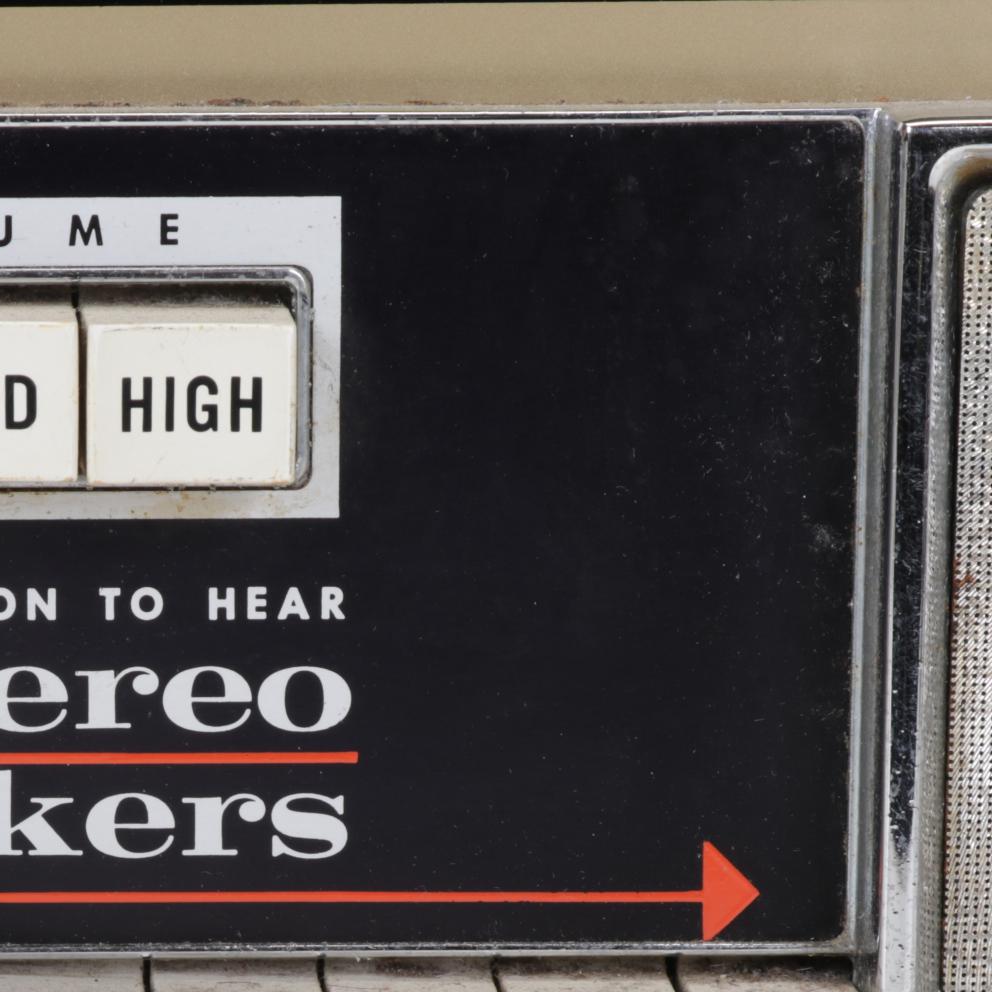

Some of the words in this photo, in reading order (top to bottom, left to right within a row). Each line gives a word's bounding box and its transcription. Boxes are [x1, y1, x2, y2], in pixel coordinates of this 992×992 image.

[121, 375, 263, 433] HIGH
[98, 586, 164, 621] TO
[208, 586, 346, 621] HEAR
